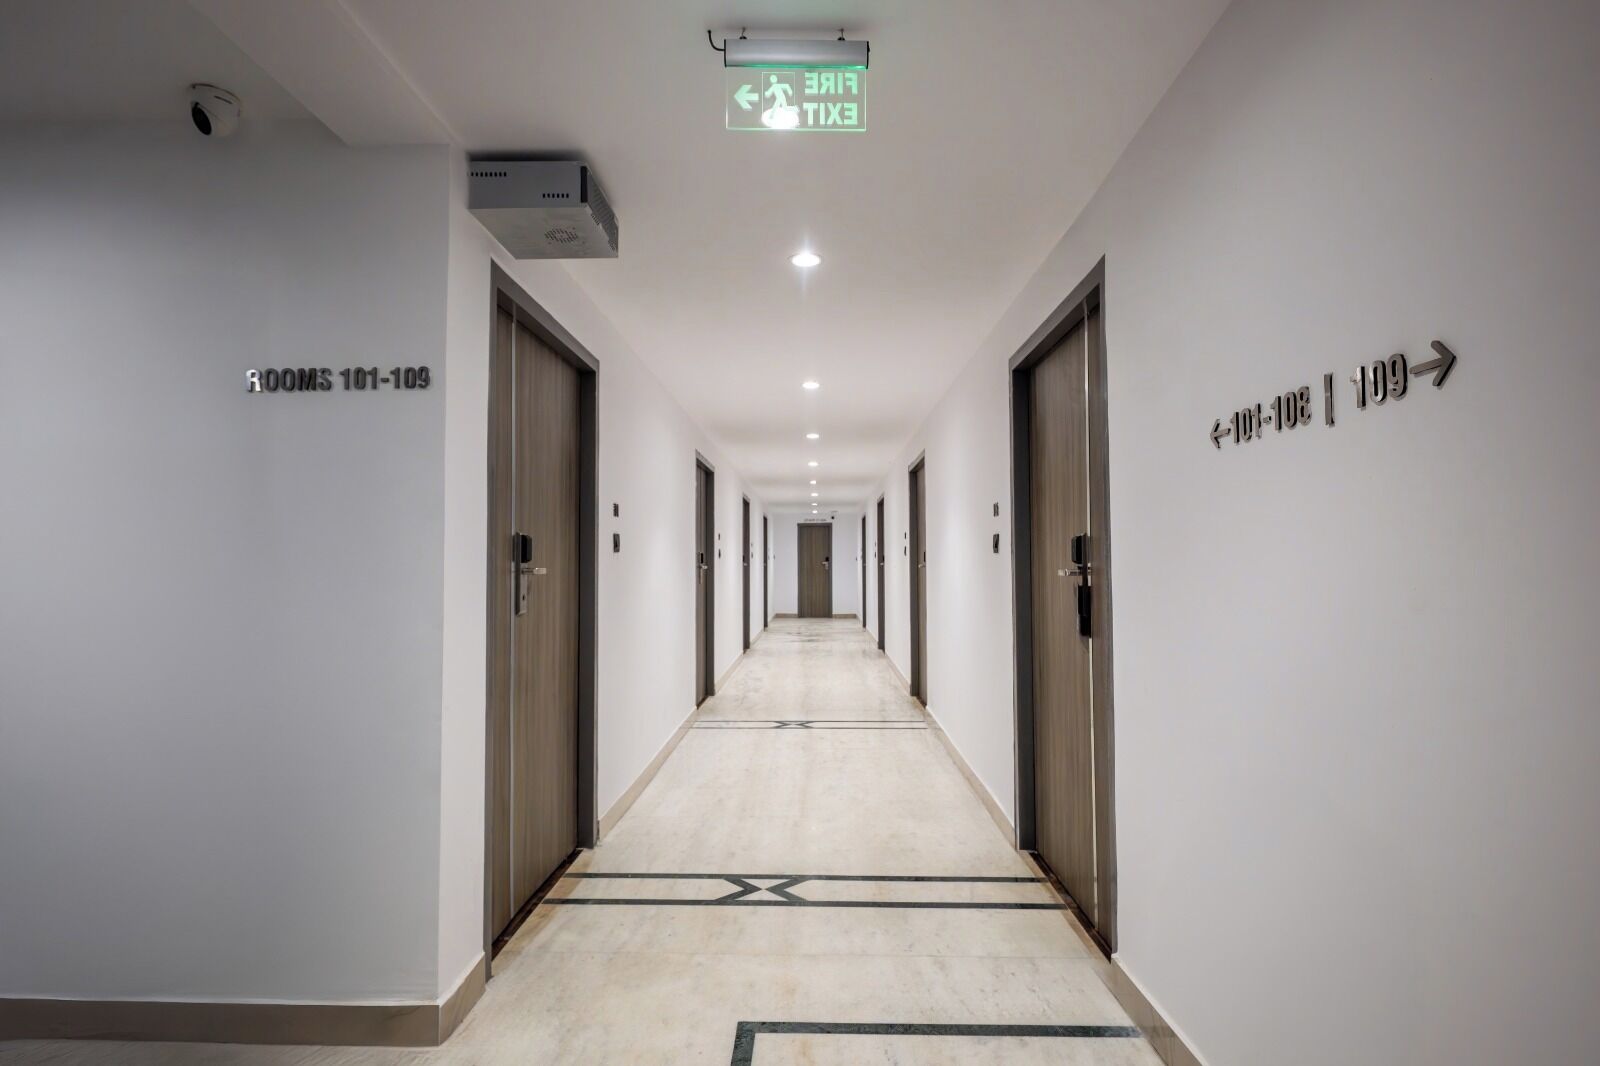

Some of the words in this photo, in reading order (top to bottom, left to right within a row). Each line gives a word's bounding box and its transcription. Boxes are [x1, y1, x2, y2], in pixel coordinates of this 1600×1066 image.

[245, 368, 333, 393] ROOMS
[339, 366, 431, 391] 101-109
[1350, 353, 1408, 410] 109
